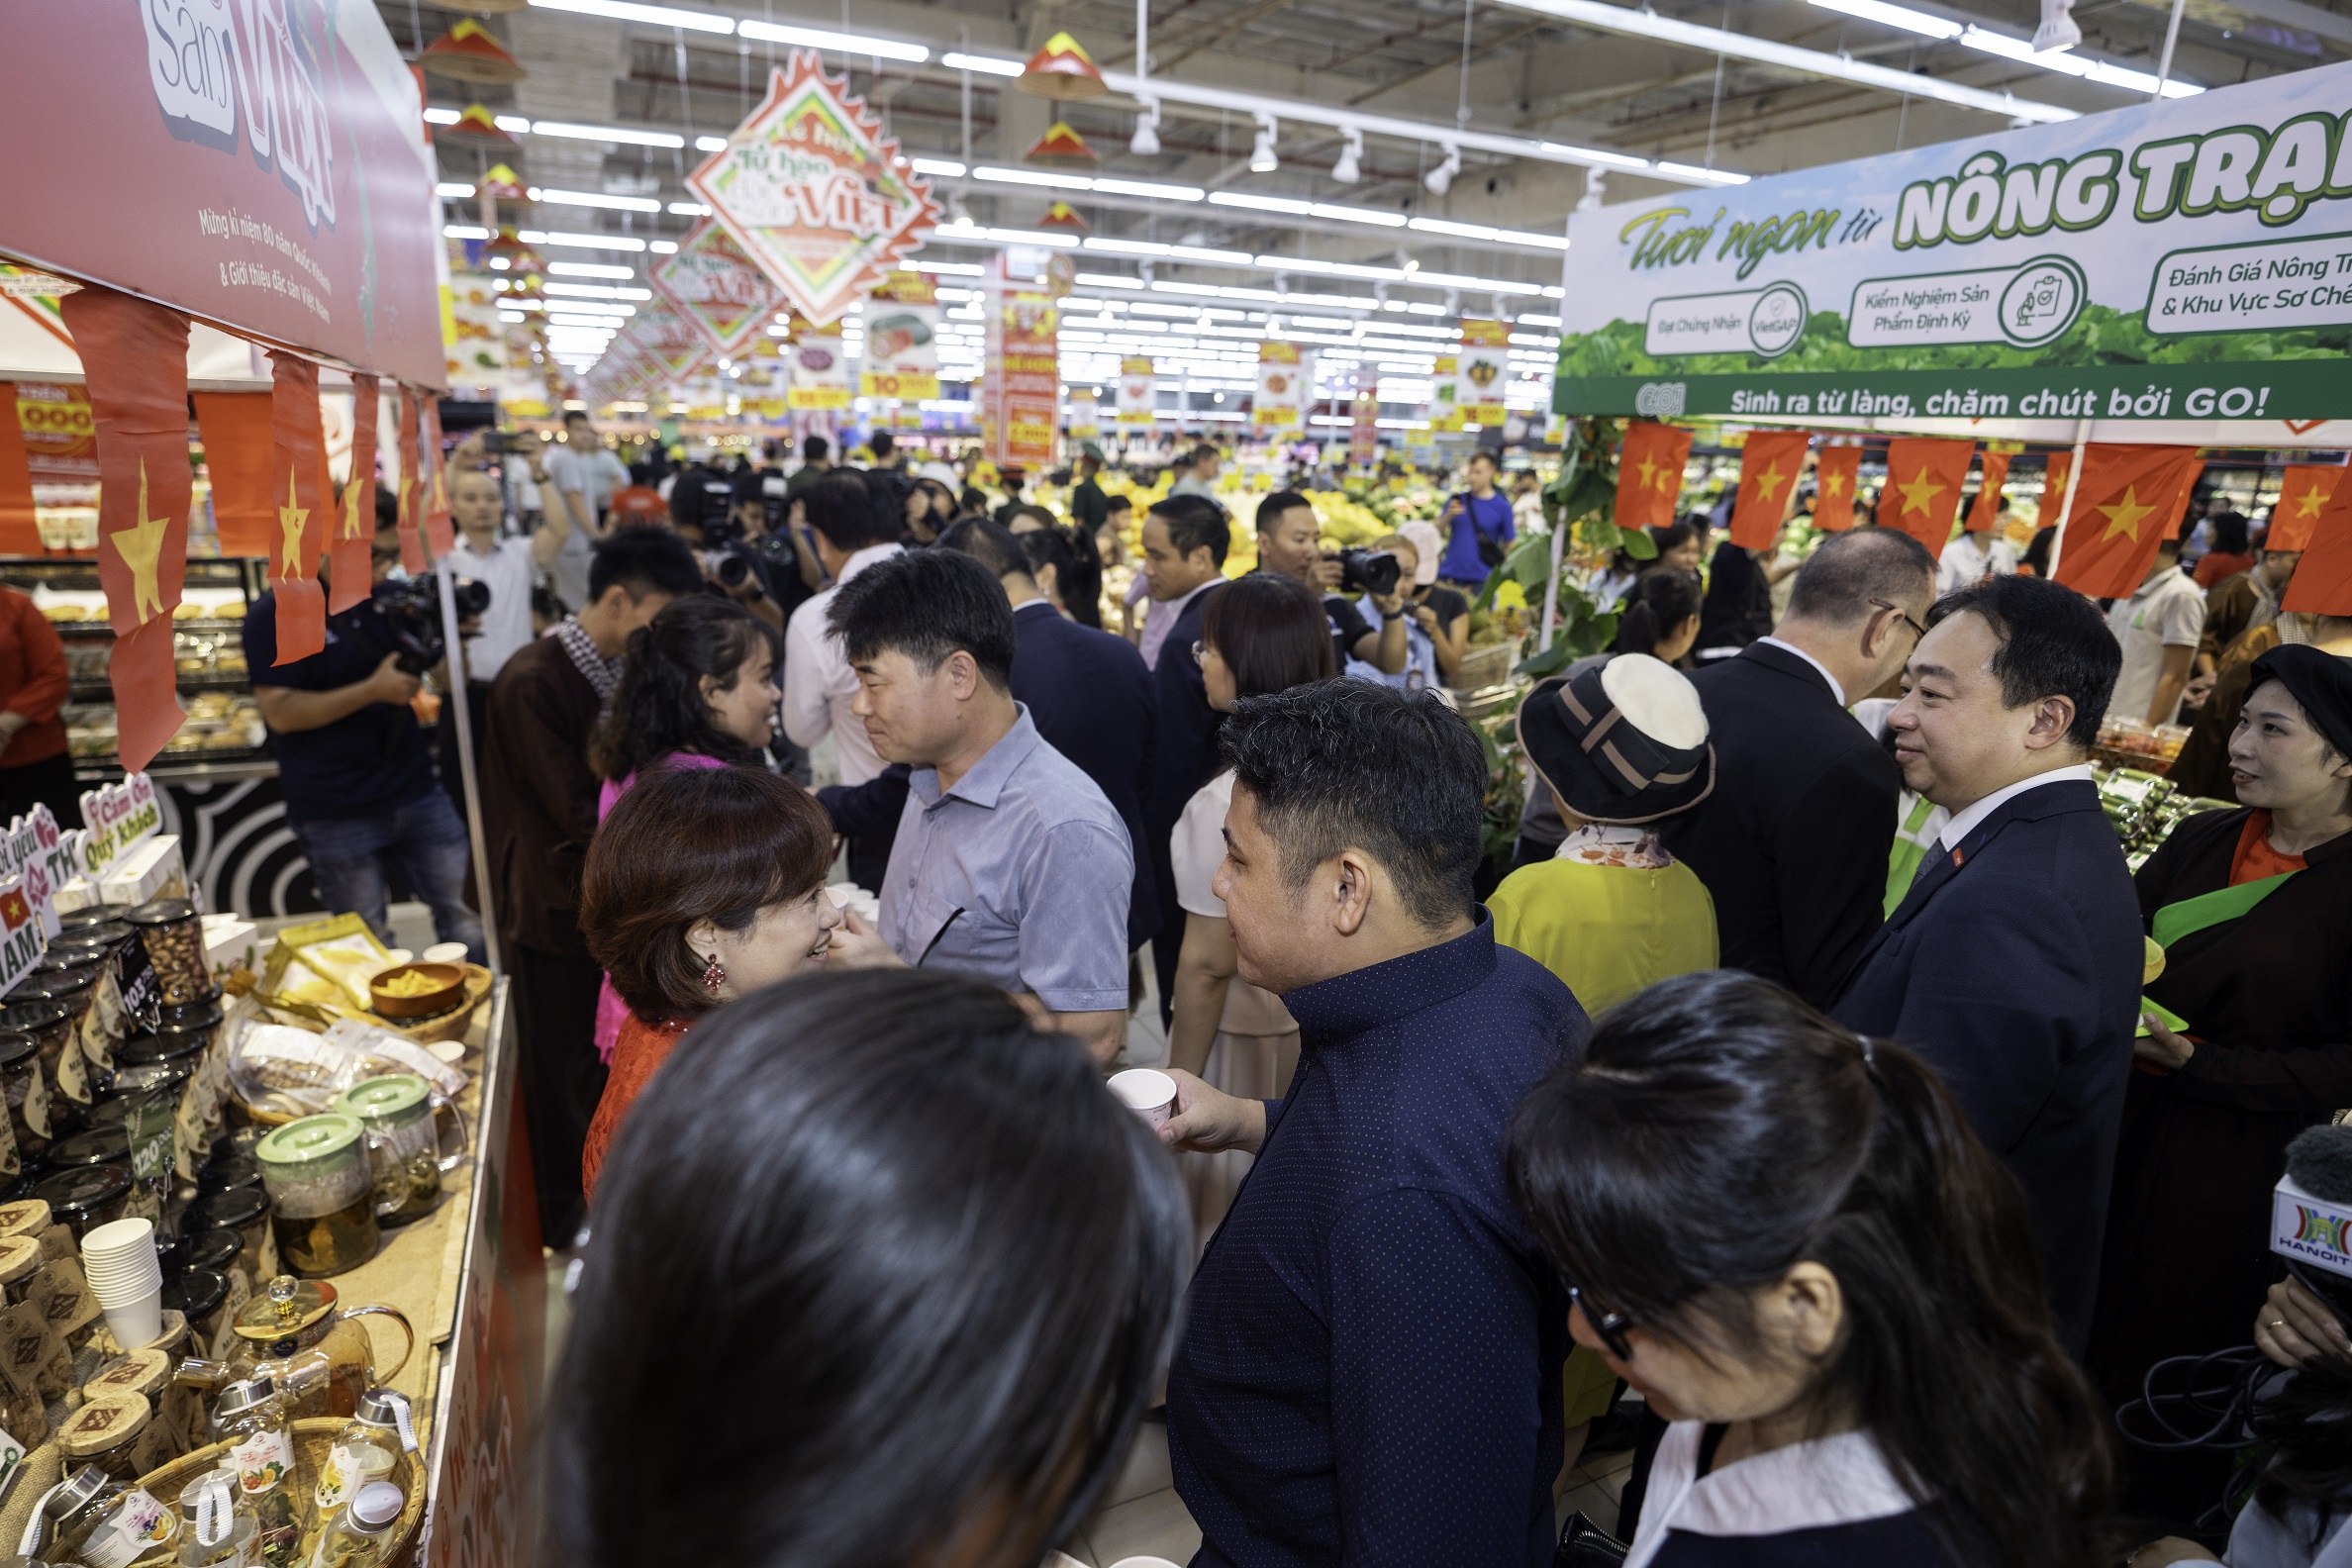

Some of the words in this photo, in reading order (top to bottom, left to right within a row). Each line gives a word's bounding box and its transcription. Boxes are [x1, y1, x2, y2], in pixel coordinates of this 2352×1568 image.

[1893, 148, 2123, 250] NÔNG
[199, 207, 230, 239] Mừng
[241, 214, 262, 245] niệm
[262, 223, 274, 246] 80
[275, 232, 292, 257] năm
[1715, 209, 1840, 281] ngon
[1839, 208, 1883, 245] từ
[220, 262, 229, 287] &
[229, 259, 248, 285] Giới
[249, 262, 271, 293] thiệu
[272, 269, 287, 297] đặc
[2169, 265, 2222, 287] Đánh
[2228, 258, 2263, 282] Giá
[2267, 255, 2329, 281] Nông
[1902, 288, 1957, 310] Nghiệm
[1960, 284, 1990, 303] Sản
[2162, 297, 2176, 315] &
[2182, 296, 2222, 315] Khu
[2229, 292, 2269, 316] Vực
[2273, 289, 2308, 309] Sơ
[1754, 319, 1798, 333] VietGAP
[1916, 313, 1948, 333] Định
[1730, 389, 1780, 414] Sinh
[1786, 395, 1811, 414] ra
[1816, 388, 1847, 414] từ
[1850, 388, 1915, 418] làng,
[1925, 388, 2009, 416] chăm
[2018, 387, 2098, 417] chút
[2107, 384, 2172, 417] bởi
[2185, 386, 2270, 417] GO!
[2280, 1236, 2352, 1267] HANOIT
